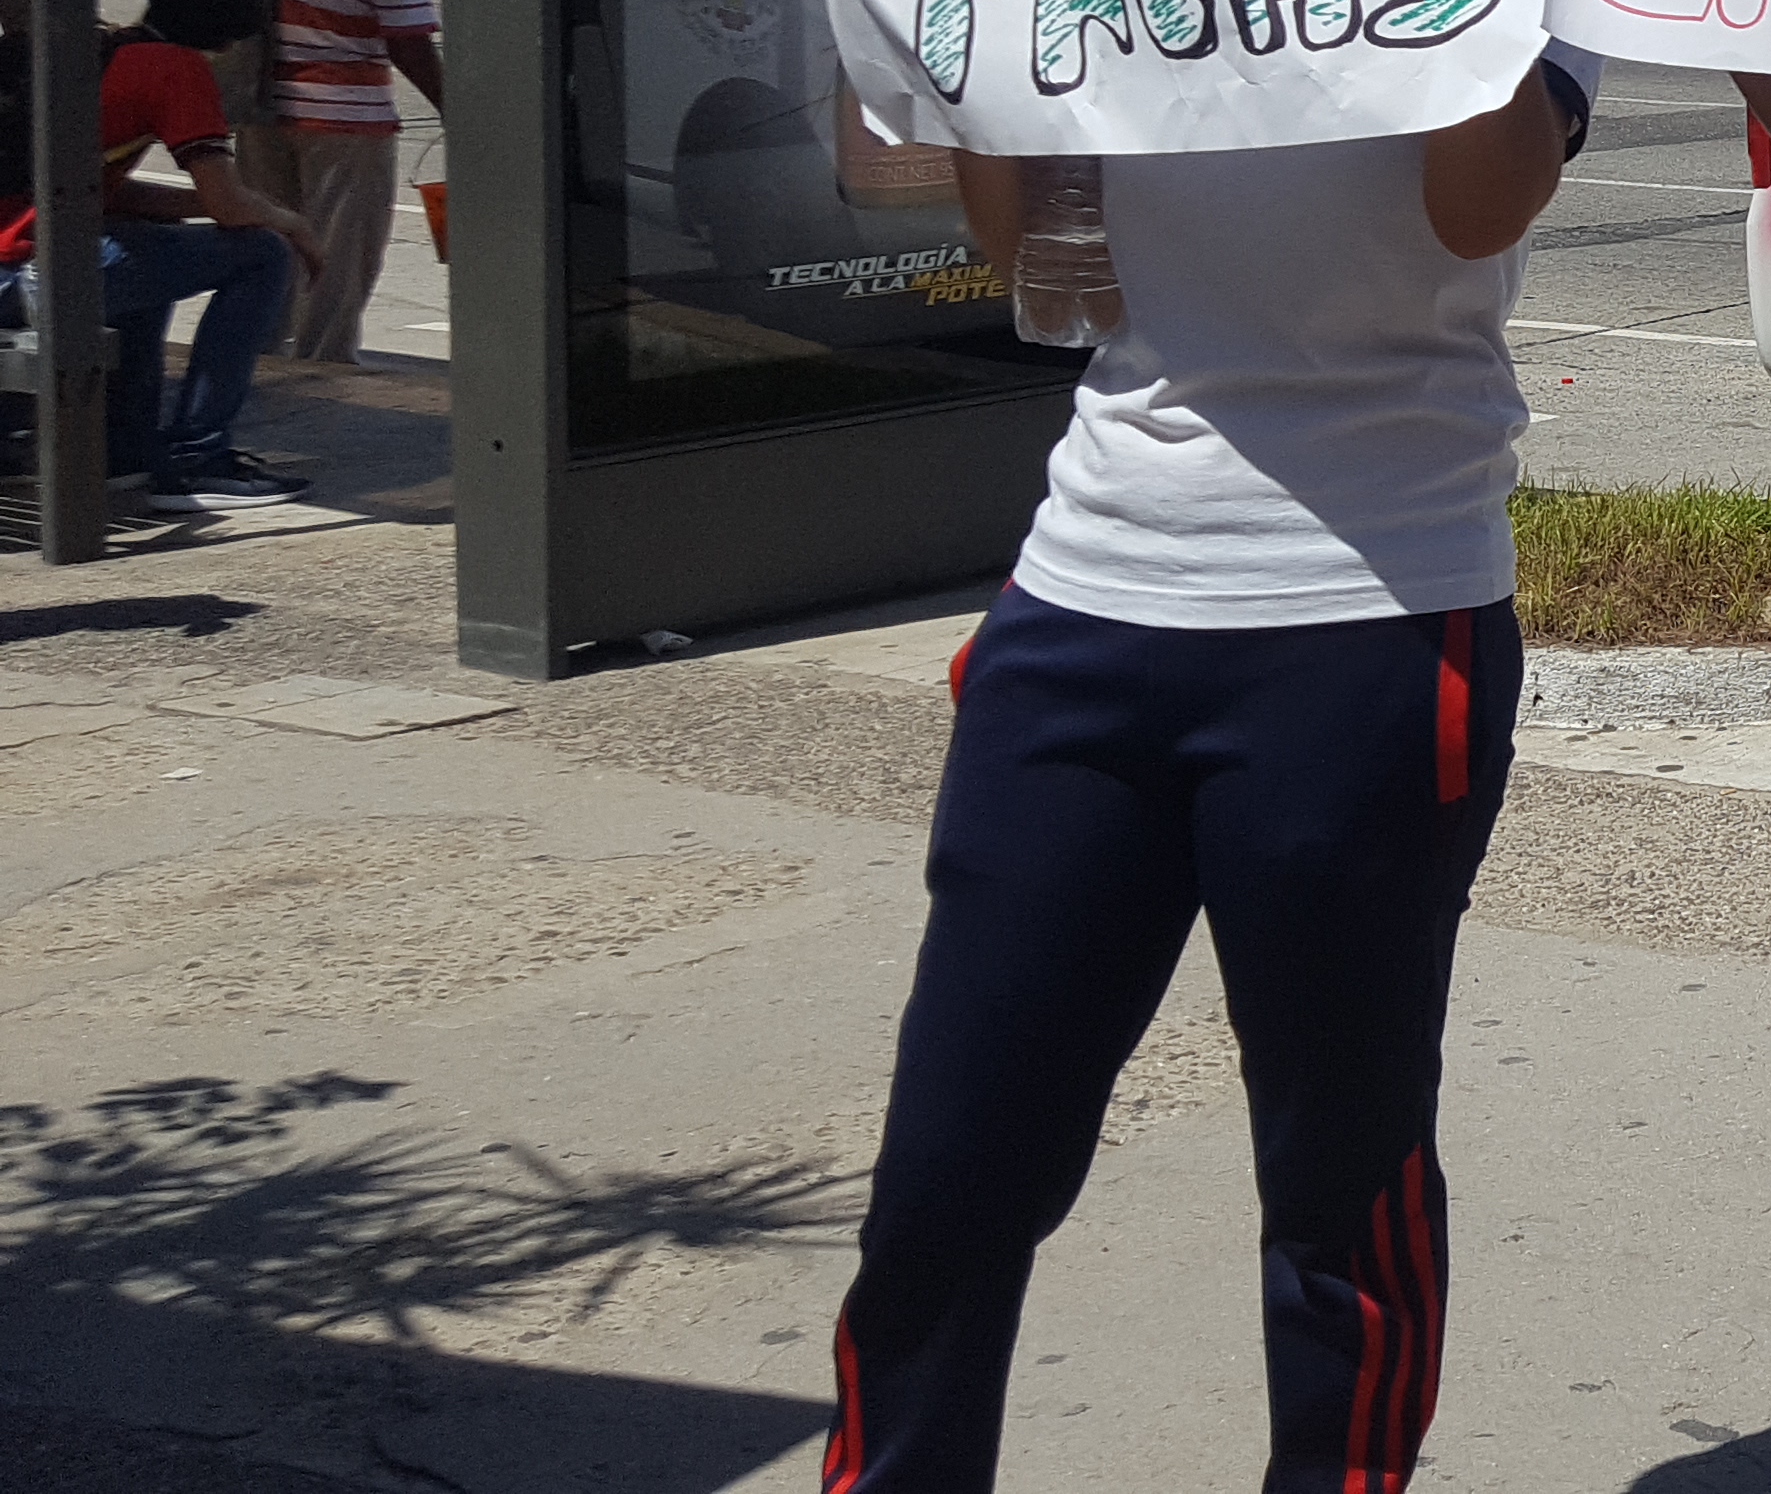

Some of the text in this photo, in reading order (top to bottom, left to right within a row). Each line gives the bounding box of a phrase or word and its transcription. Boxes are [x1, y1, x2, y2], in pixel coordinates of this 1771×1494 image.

[768, 242, 968, 286] TECNOLOGÍA
[844, 279, 863, 296] A
[871, 275, 906, 293] LA
